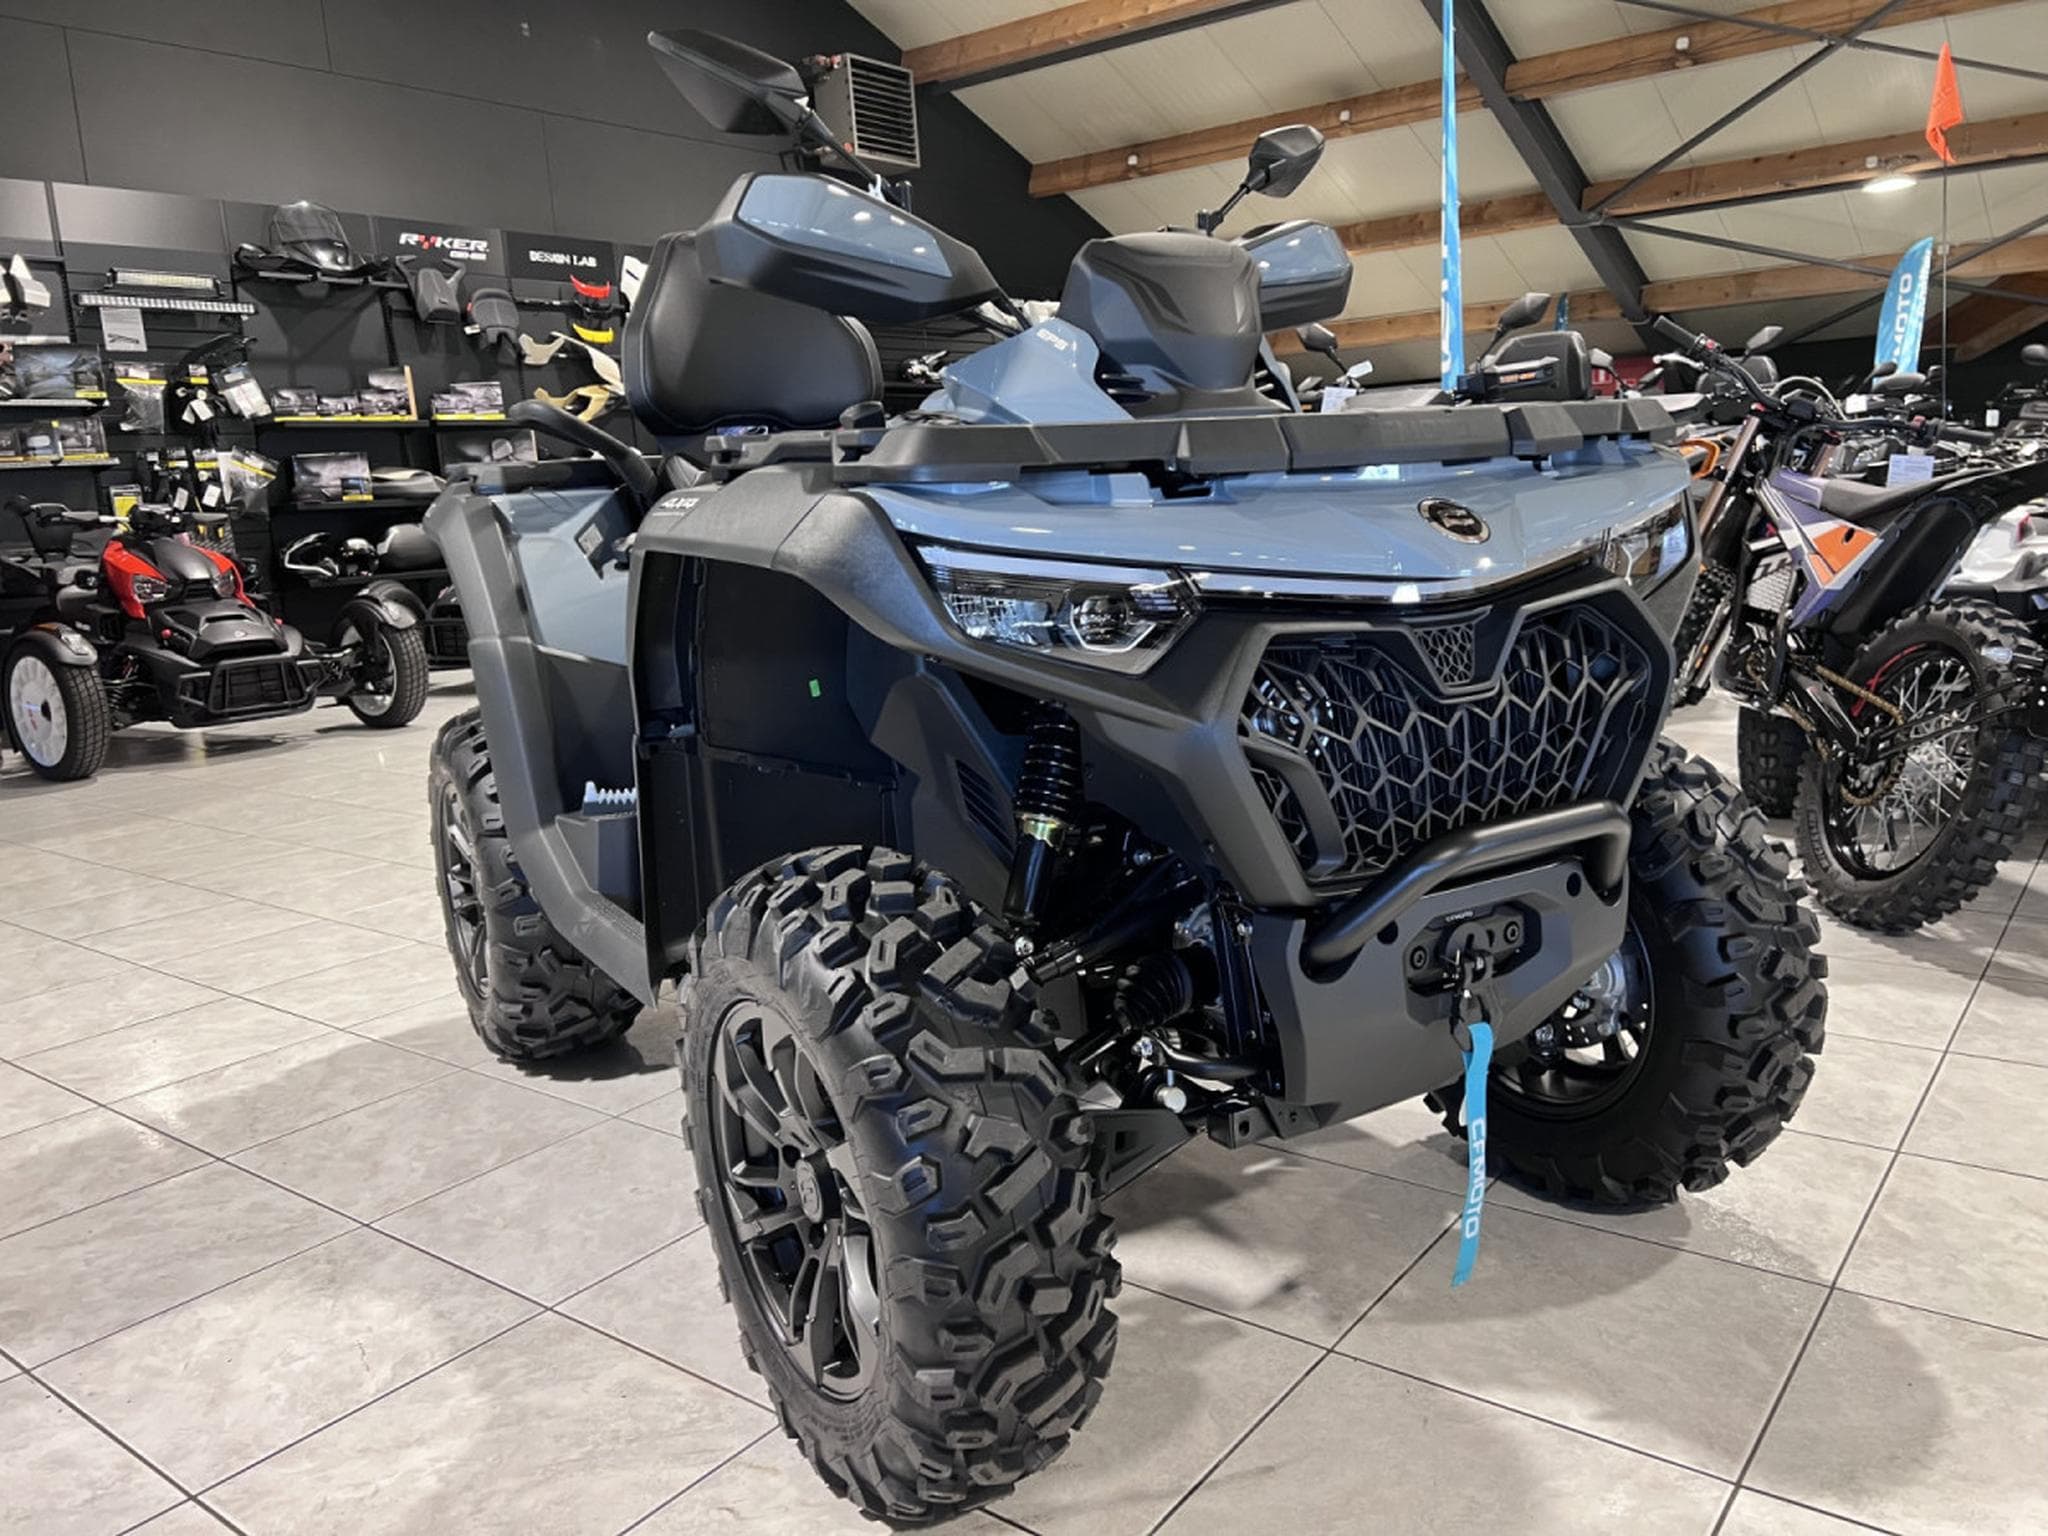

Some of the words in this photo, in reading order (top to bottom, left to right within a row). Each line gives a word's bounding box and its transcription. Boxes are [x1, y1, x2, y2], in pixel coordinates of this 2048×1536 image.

[399, 232, 488, 252] RYKER
[529, 250, 571, 265] DESIGN
[572, 254, 597, 267] LAB
[1893, 272, 1913, 364] MOTO
[1465, 1118, 1486, 1239] CFMOTO
